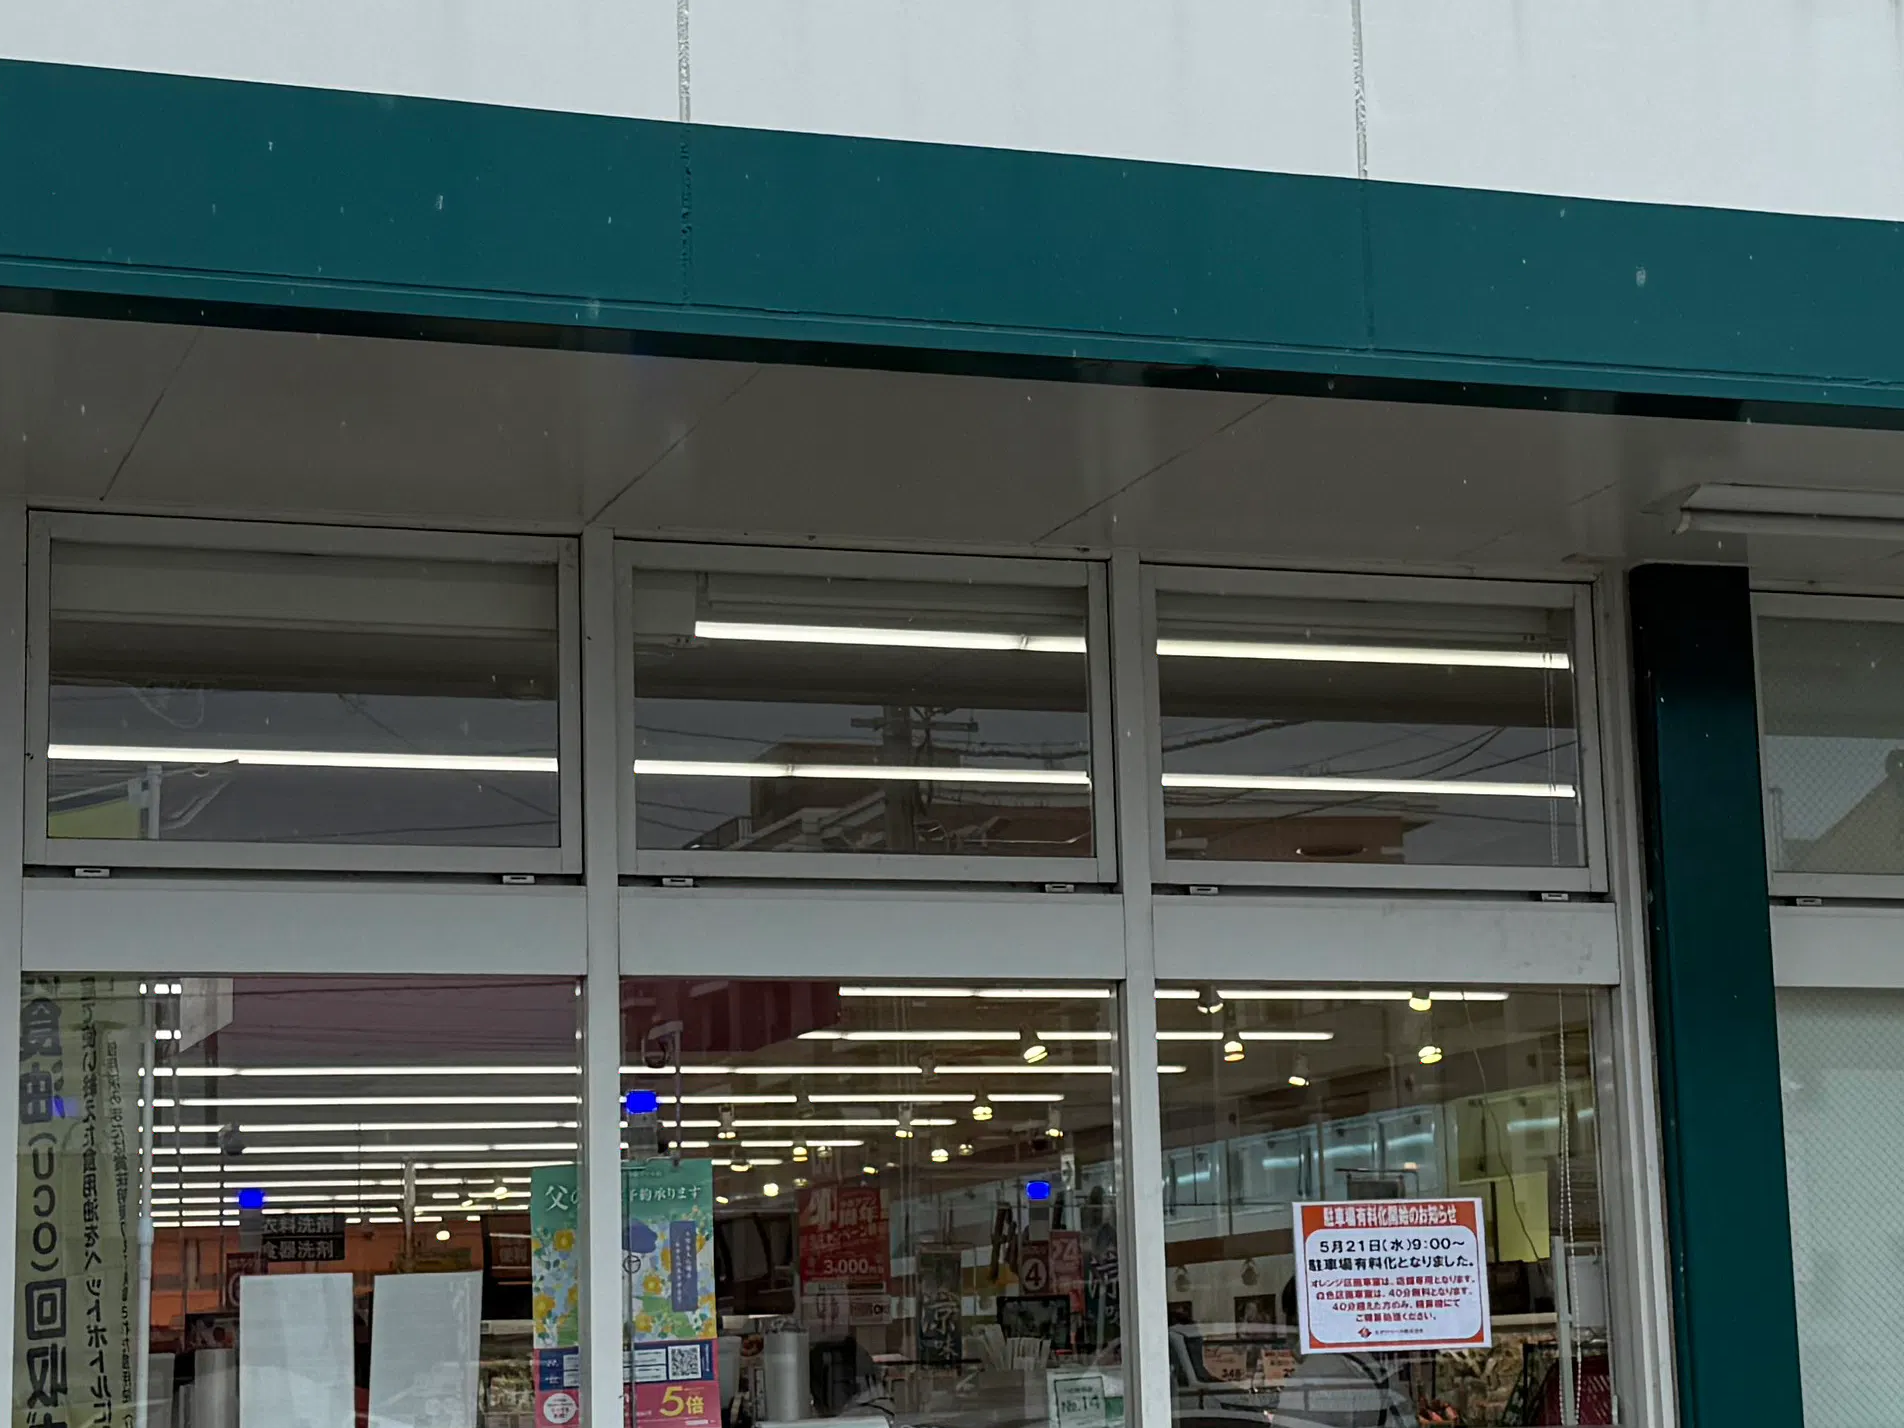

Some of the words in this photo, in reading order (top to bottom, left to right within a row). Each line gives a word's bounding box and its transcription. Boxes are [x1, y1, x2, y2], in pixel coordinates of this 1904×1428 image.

[1308, 1255, 1474, 1272] 駐車場有料化となりました。
[659, 1385, 705, 1417] 5倍
